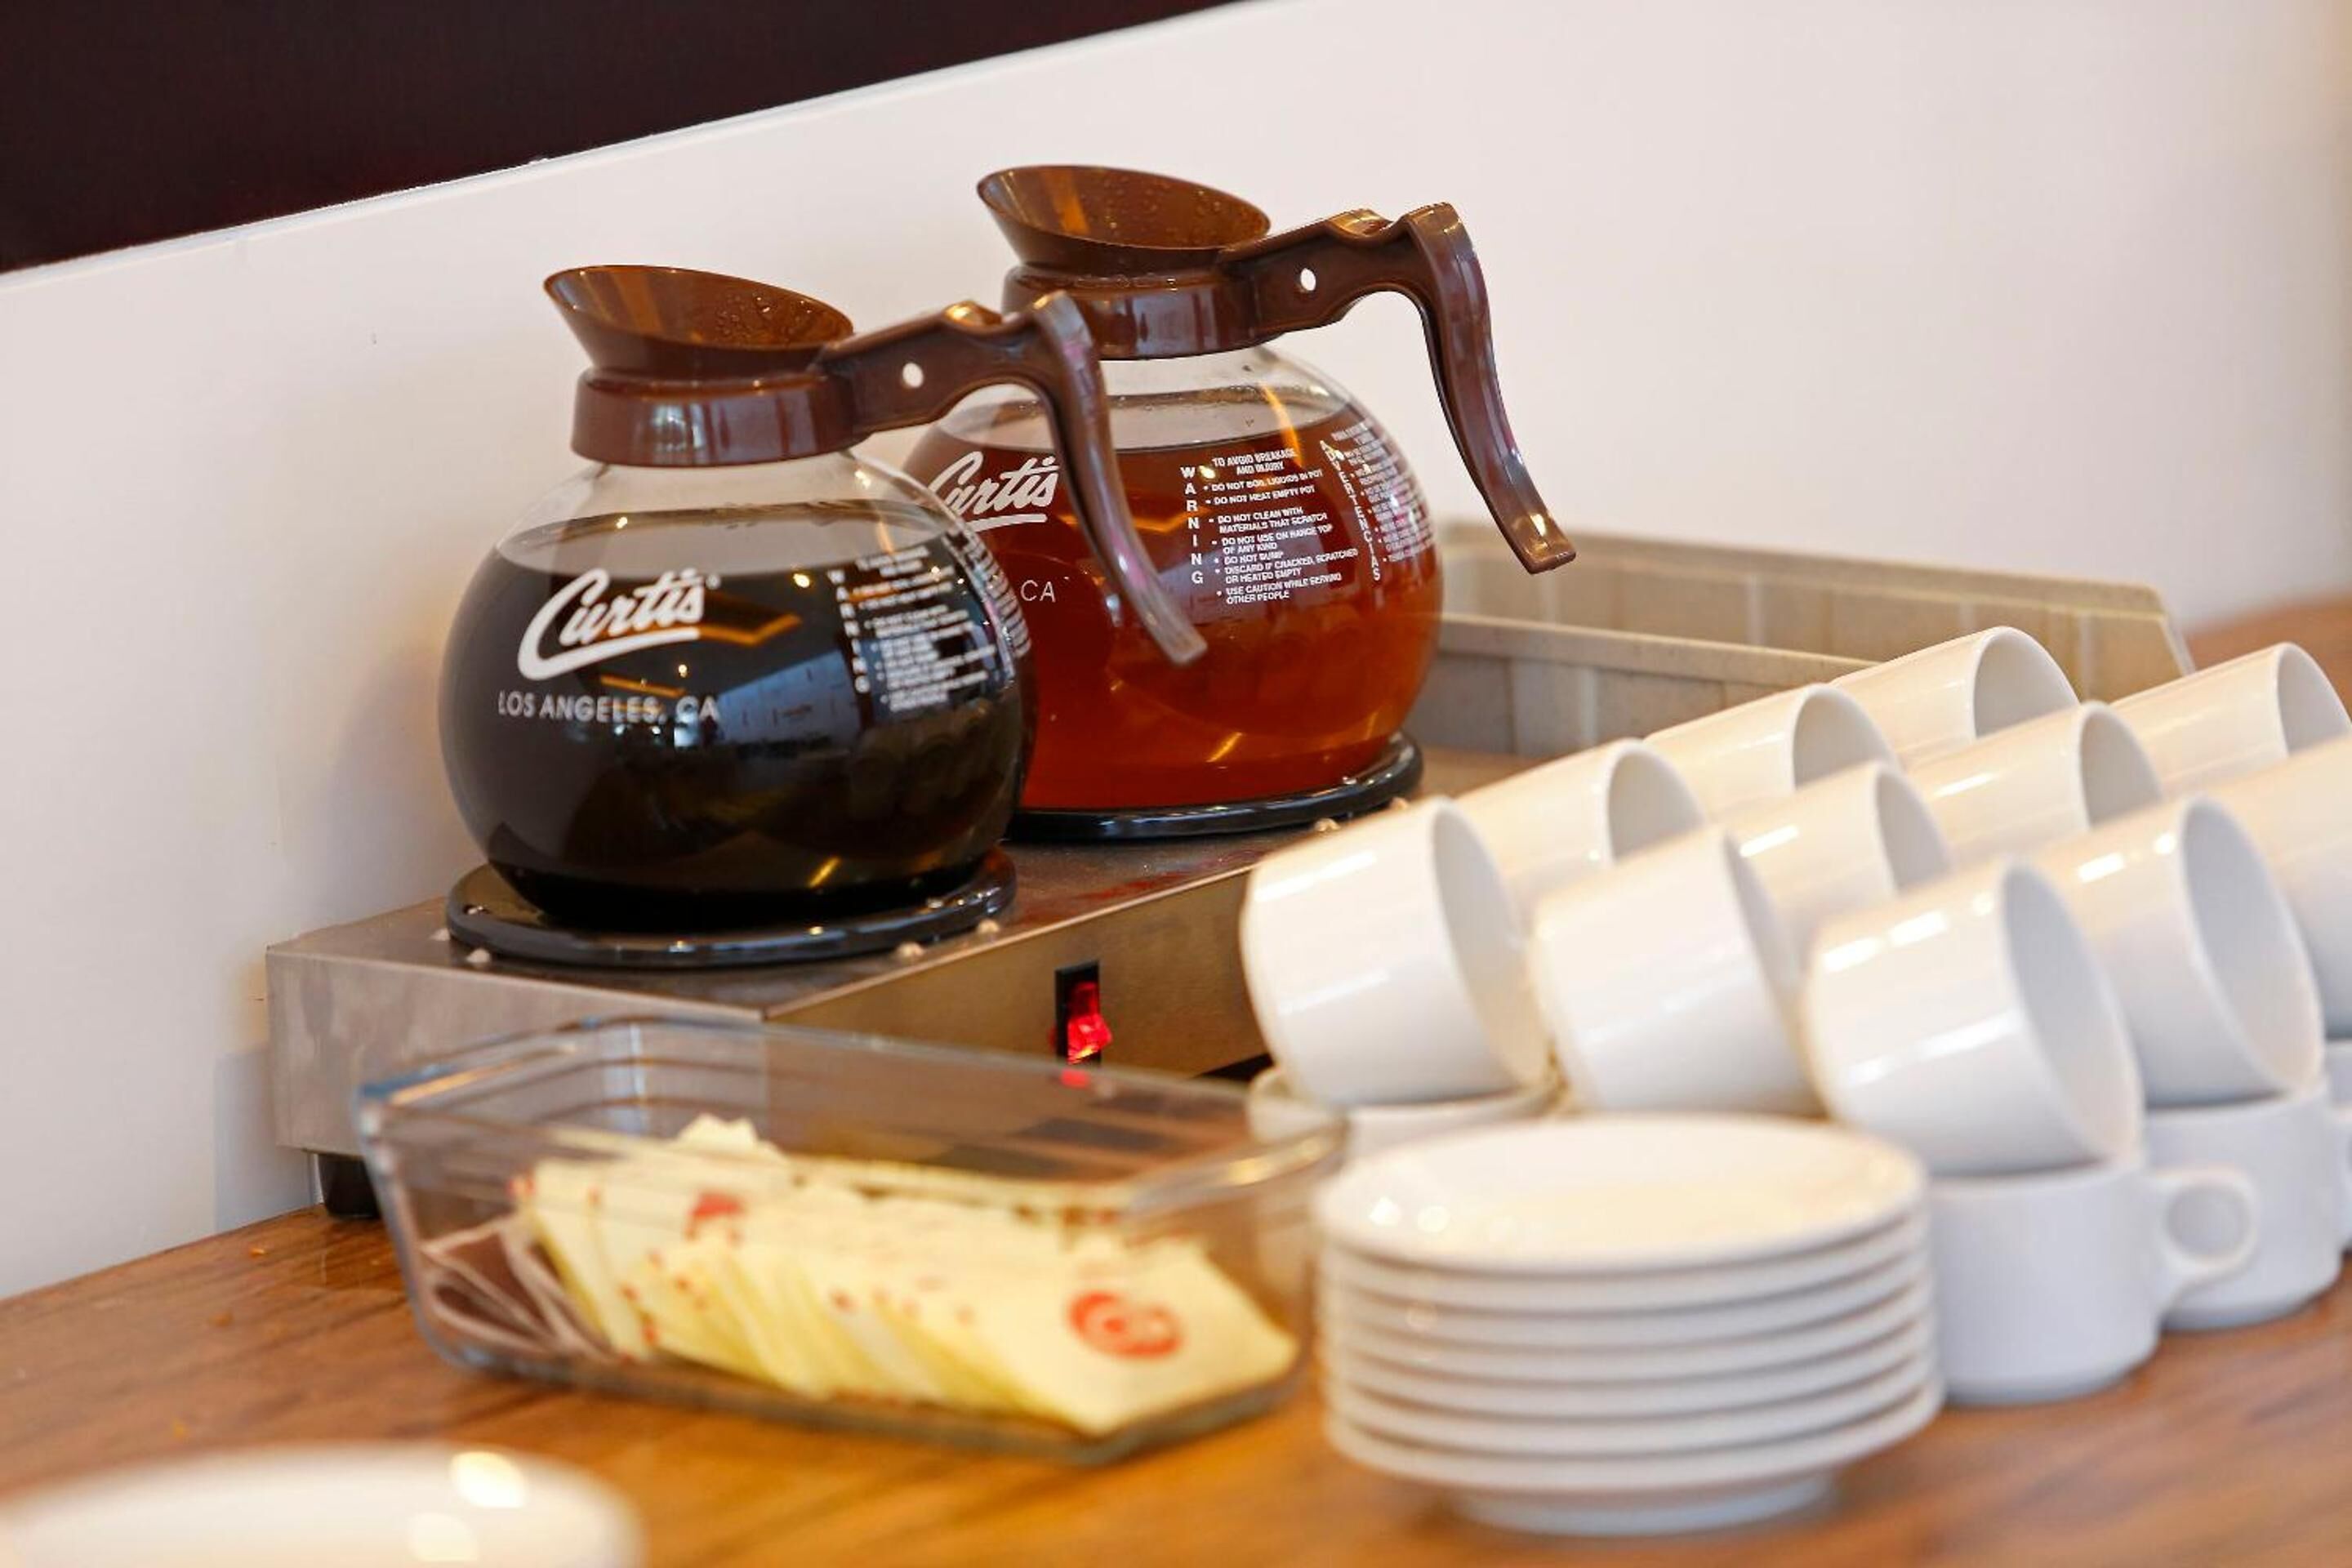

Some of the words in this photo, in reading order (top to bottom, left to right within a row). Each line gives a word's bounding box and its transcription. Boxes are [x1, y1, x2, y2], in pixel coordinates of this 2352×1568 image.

[1212, 458, 1225, 466] TO
[1227, 455, 1253, 466] AVOID
[1254, 448, 1297, 462] BREAKAGE
[1236, 466, 1254, 475] AND
[1255, 461, 1284, 473] INJURY
[1211, 483, 1225, 492] DO
[1227, 481, 1245, 490] NOT
[1246, 479, 1267, 488] BOIL
[1267, 474, 1298, 485] LIQUIDS
[1309, 469, 1323, 479] POT
[1229, 494, 1247, 503] NOT
[1250, 491, 1271, 501] HEAT
[1273, 488, 1299, 499] EMPTY
[1302, 485, 1315, 493] POT
[1218, 515, 1231, 524] DO
[1233, 513, 1251, 523] NOT
[1254, 510, 1281, 520] CLEAN
[1282, 506, 1303, 516] WITH
[1219, 521, 1267, 533] MATERIALS
[1270, 518, 1290, 528] THAT
[1292, 513, 1327, 524] SCRATCH
[1222, 537, 1236, 546] DO
[1237, 535, 1256, 544] NOT
[1258, 532, 1275, 542] USE
[1276, 532, 1290, 541] ON
[1290, 527, 1317, 537] RANGE
[1317, 524, 1333, 533] TOP
[1223, 546, 1236, 555] OF
[1238, 544, 1257, 554] ANY
[1258, 542, 1277, 551] KIND
[1224, 556, 1238, 565] DO
[1240, 554, 1258, 563] NOT
[1225, 564, 1263, 576] DISCARD
[1265, 562, 1273, 570] IF
[1316, 549, 1358, 563] SCRATCHED
[1226, 576, 1239, 584] OR
[1240, 572, 1273, 582] HEATED
[1275, 568, 1303, 579] EMPTY
[1226, 586, 1244, 596] USE
[1245, 581, 1282, 593] CAUTION
[1284, 578, 1307, 588] WHILE
[1310, 572, 1342, 585] SERVING
[1020, 580, 1056, 603] CA
[1227, 593, 1256, 604] OTHER
[1258, 590, 1290, 601] PEOPLE
[517, 568, 706, 680] Curtis
[497, 691, 536, 717] LOS
[675, 696, 719, 724] CA
